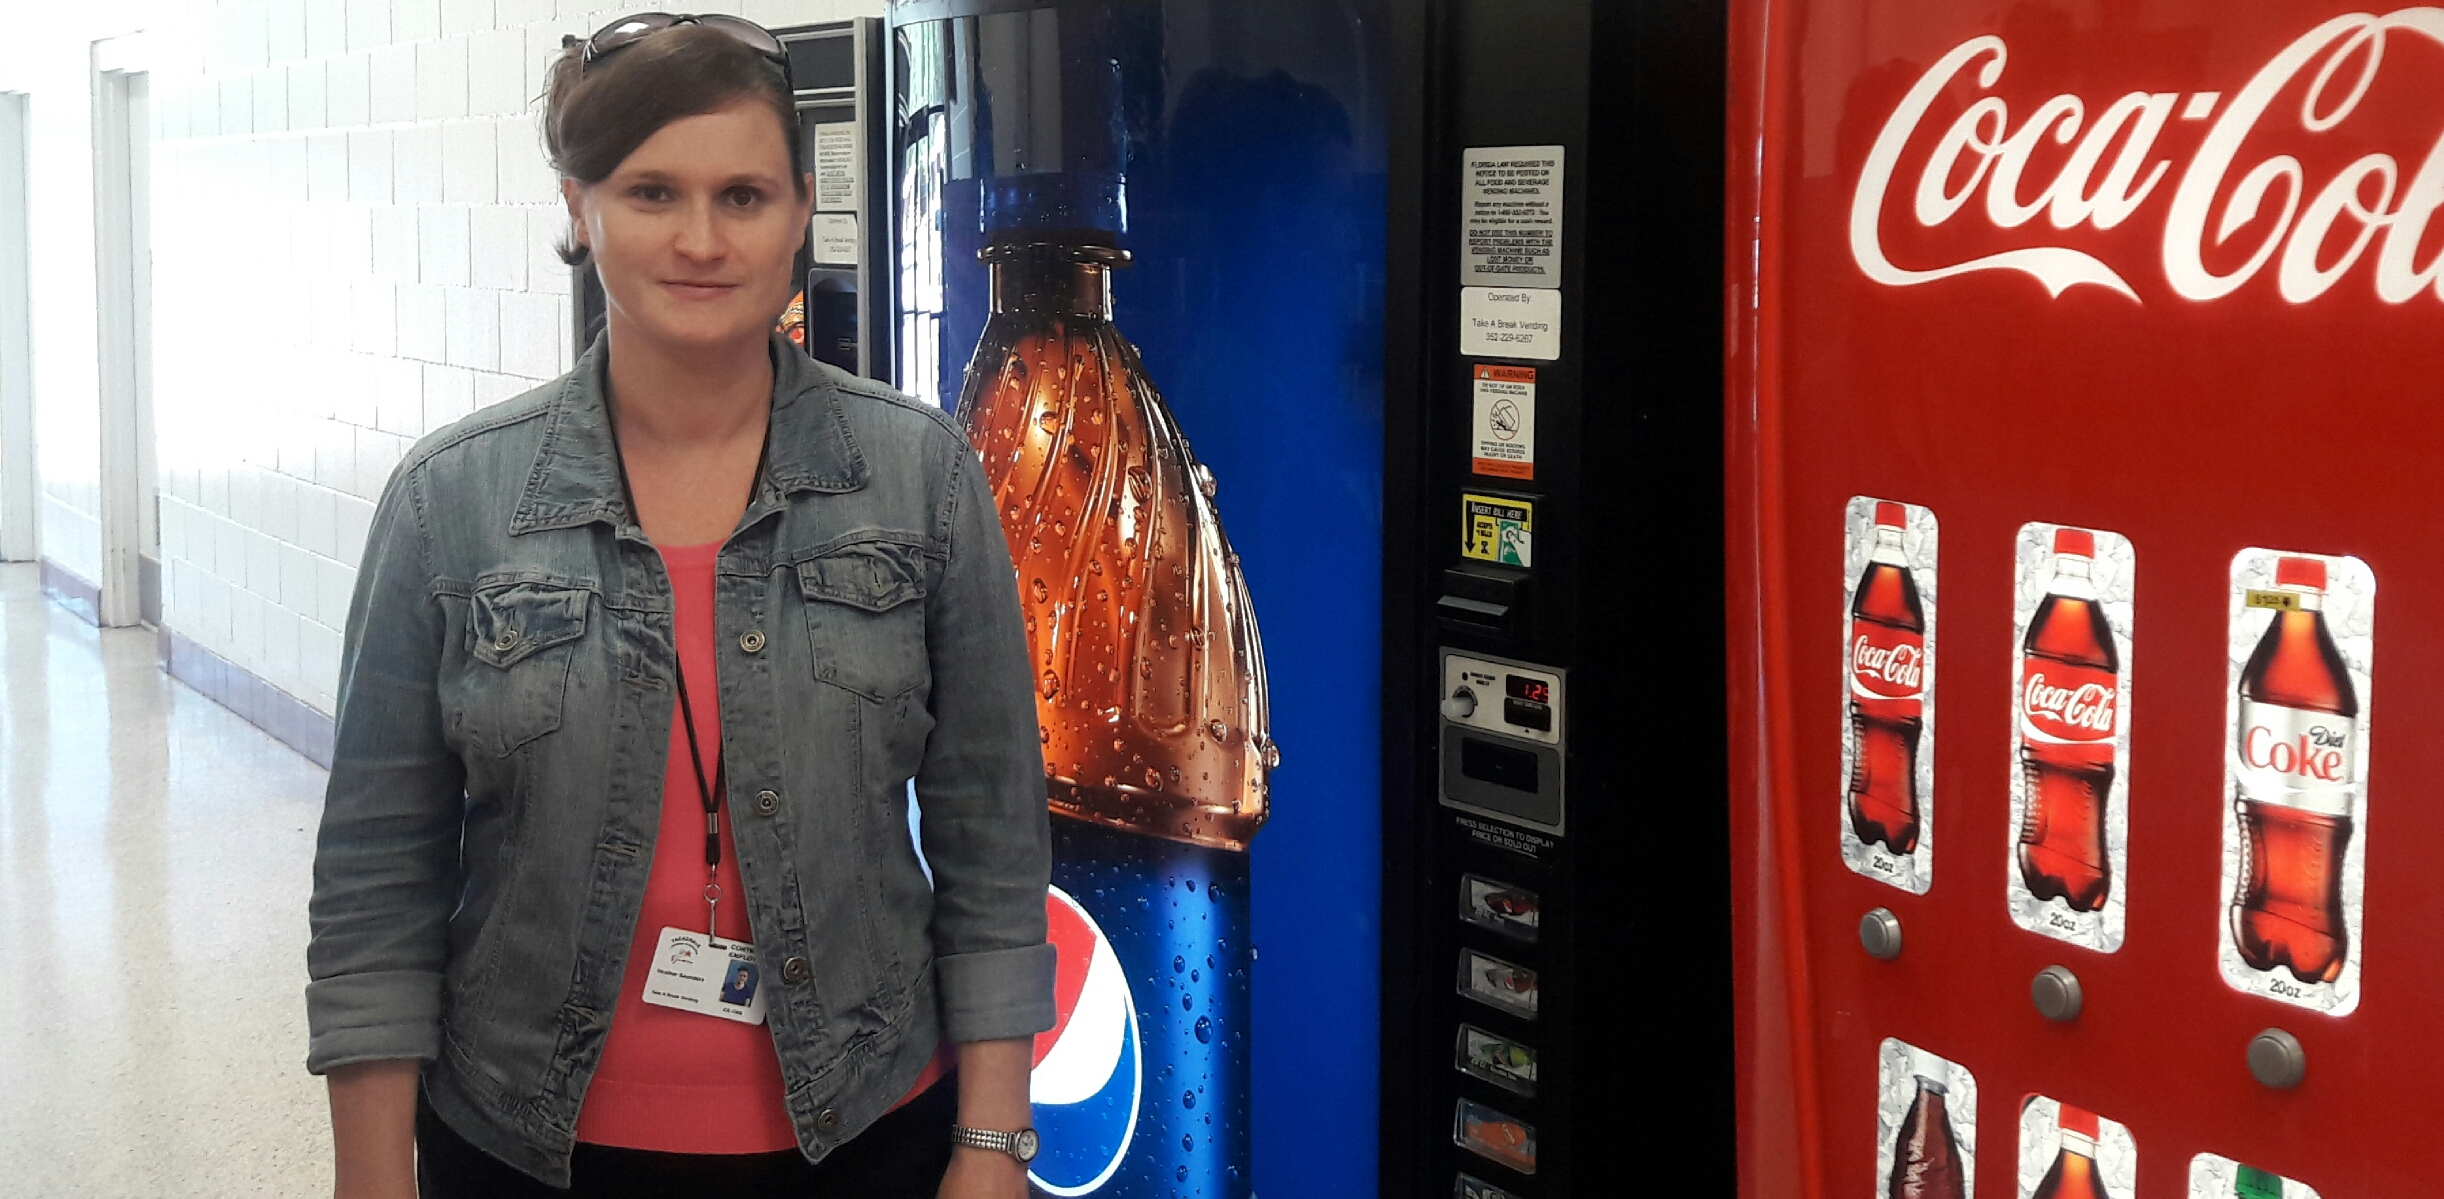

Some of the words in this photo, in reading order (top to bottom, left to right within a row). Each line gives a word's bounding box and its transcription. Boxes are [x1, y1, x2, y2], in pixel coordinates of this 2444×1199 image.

[1849, 8, 2444, 305] Coca-Col
[1488, 292, 1520, 302] Operated
[1521, 293, 1531, 304] By
[1472, 318, 1489, 328] Take
[1490, 319, 1495, 327] A
[1497, 319, 1517, 329] Break
[1520, 321, 1548, 332] Vending
[1493, 369, 1533, 380] WARNING
[1471, 501, 1491, 515] INSERT
[1493, 507, 1505, 517] BILL
[1506, 510, 1523, 520] HERE
[1853, 634, 1922, 688] Coca-Cola
[2025, 672, 2116, 732] Coca-Cola
[2309, 725, 2346, 749] Diet
[2245, 725, 2345, 782] Coke
[1456, 816, 1477, 829] PRESS
[1478, 822, 1515, 838] SELECTION
[1515, 831, 1525, 841] TO
[1525, 834, 1554, 848] DISPLAY
[1472, 829, 1491, 841] PRICE
[1492, 836, 1502, 844] OR
[1503, 838, 1522, 849] SOLD
[1522, 842, 1537, 853] OUT
